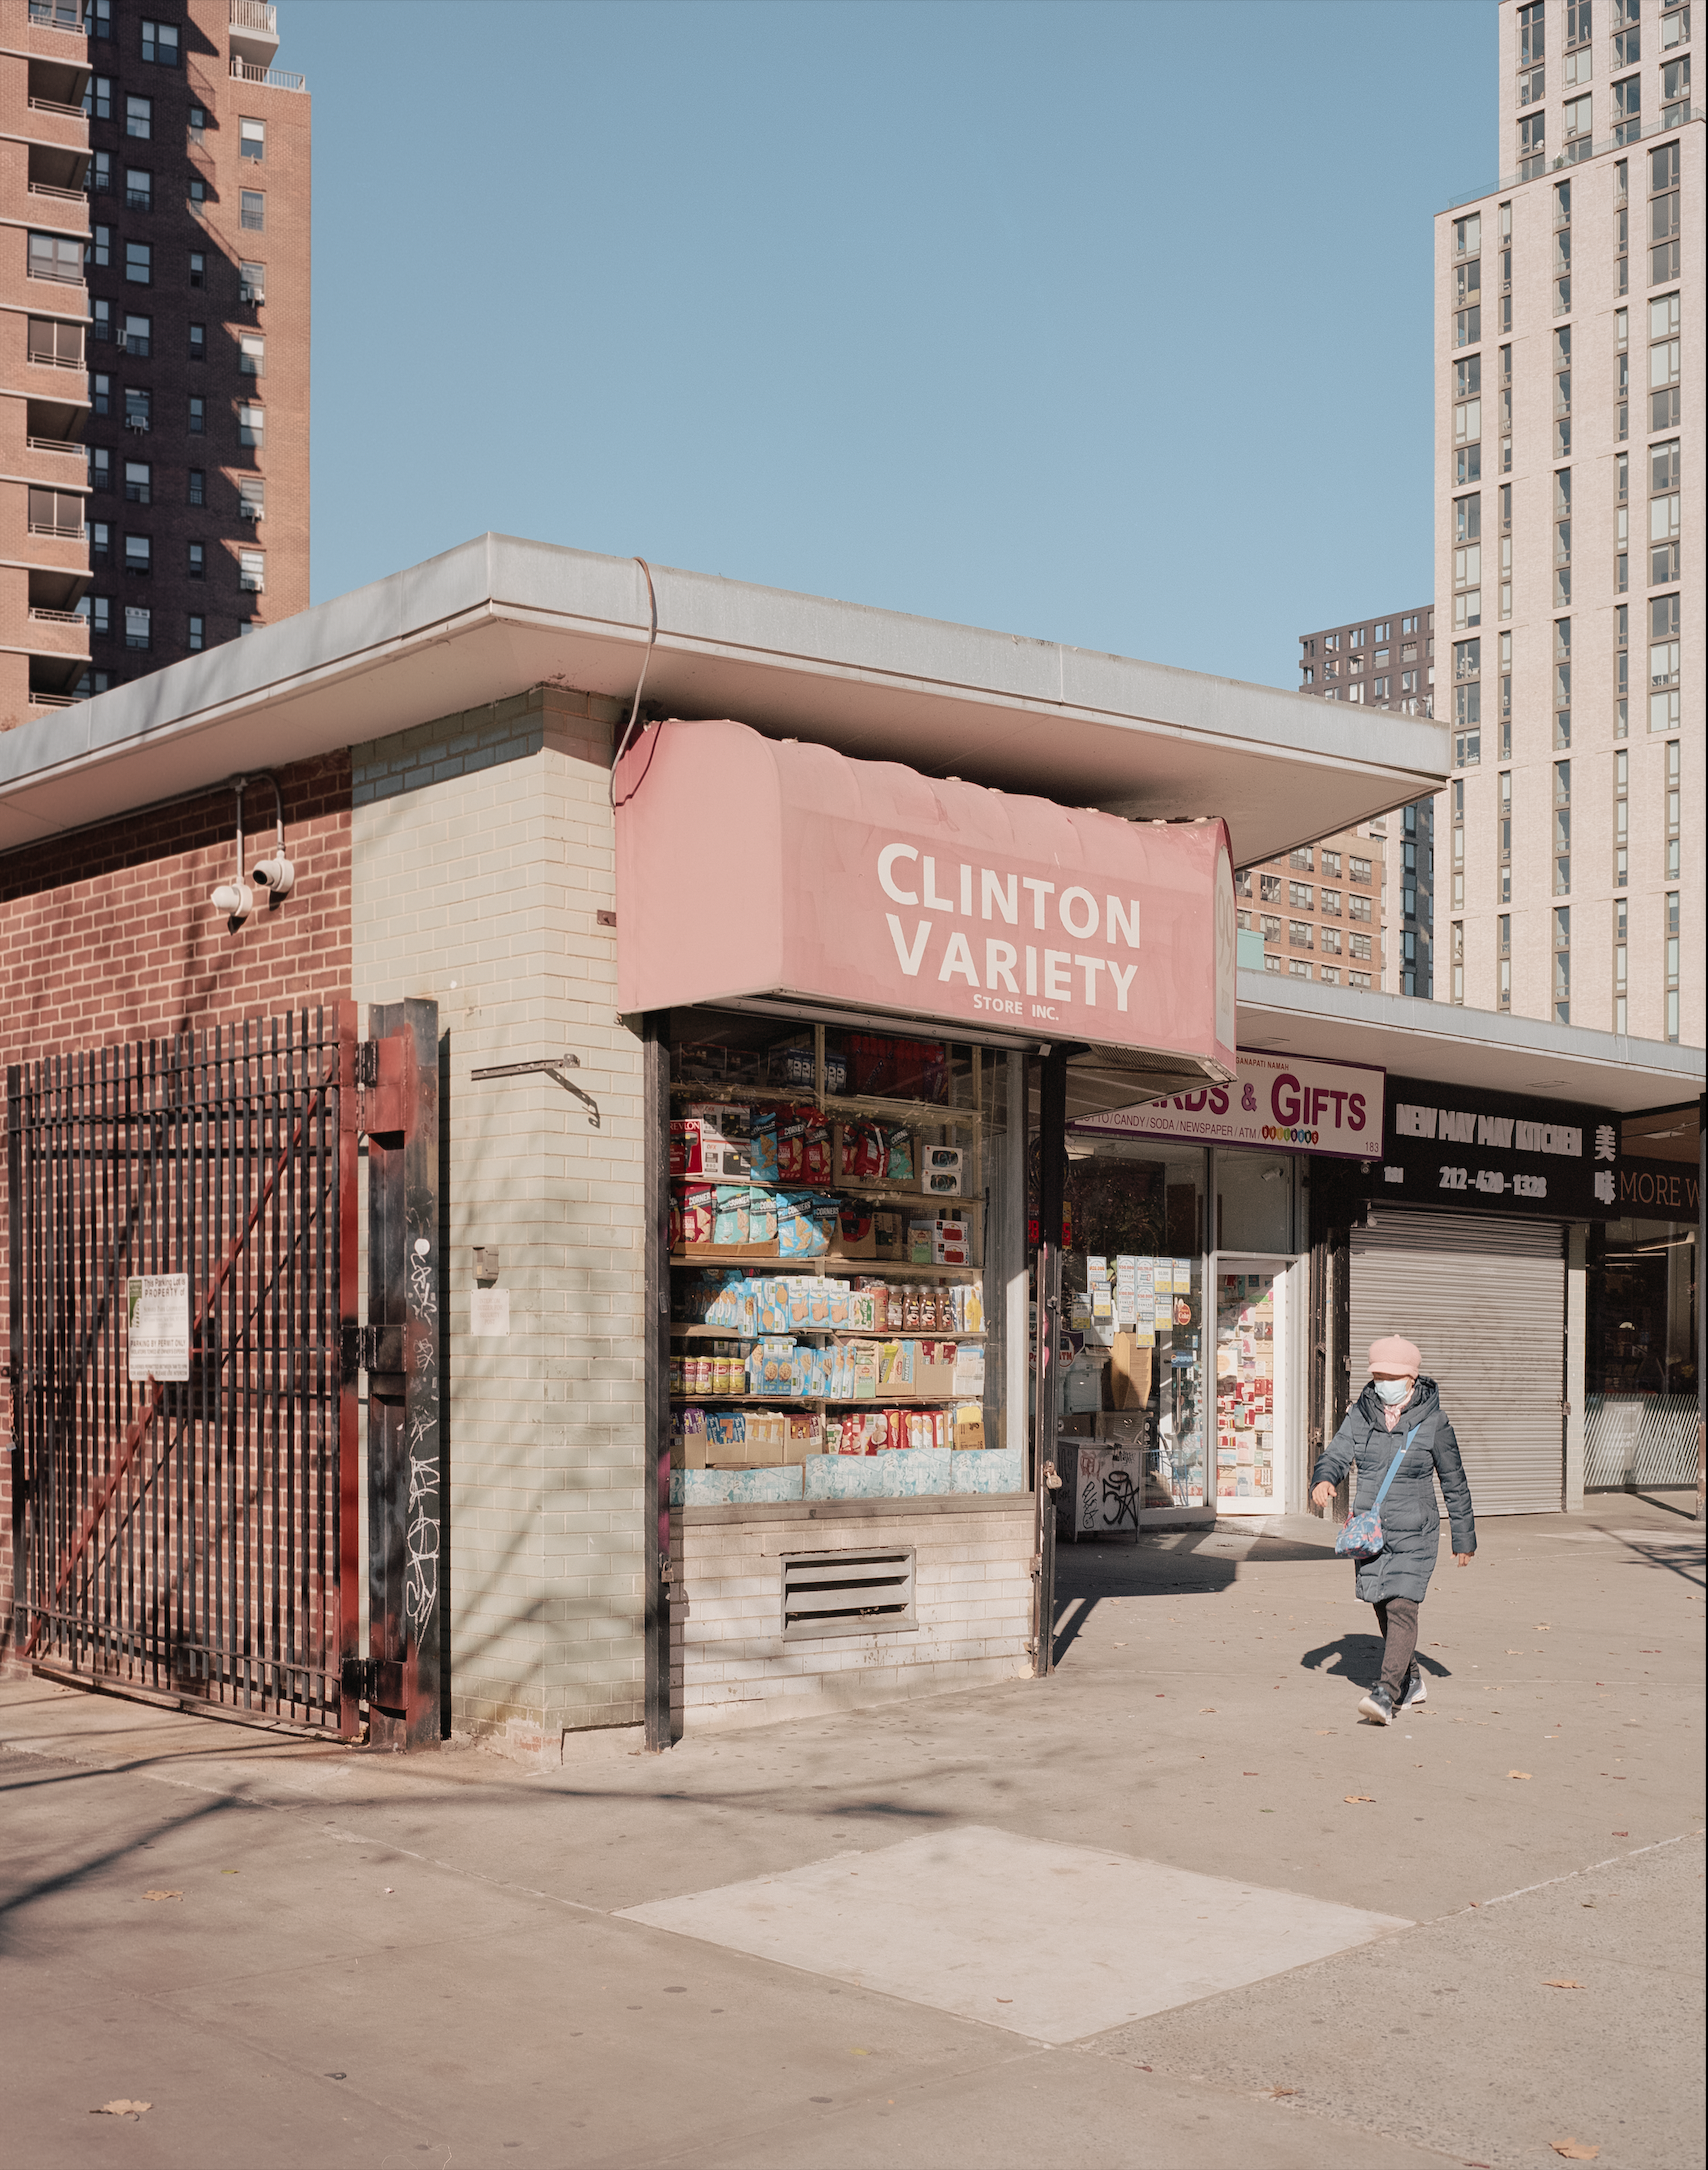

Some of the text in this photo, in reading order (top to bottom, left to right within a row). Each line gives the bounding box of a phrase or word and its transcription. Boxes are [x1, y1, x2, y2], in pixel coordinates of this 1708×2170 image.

[878, 843, 1140, 949] CLINTON
[885, 913, 1138, 1012] VARIETY
[973, 993, 1059, 1021] STORE INC.
[1267, 1061, 1289, 1071] NAMAH
[1241, 1083, 1257, 1112] &
[1271, 1073, 1366, 1131] GIFTS
[670, 1121, 700, 1130] REVLON
[1081, 1114, 1109, 1123] OTTO
[1114, 1113, 1145, 1127] CANDY
[1150, 1117, 1174, 1130] SODA
[1180, 1121, 1233, 1136] NEWSPAPER
[1240, 1127, 1256, 1139] ATM
[1396, 1103, 1582, 1157] NEW MAY MAY KITCHEN
[1365, 1141, 1379, 1152] 183
[1439, 1166, 1547, 1198] 212-420-1328
[1620, 1170, 1681, 1207] MORE
[144, 1279, 154, 1287] This
[154, 1279, 172, 1288] Parking
[173, 1278, 181, 1286] Lot
[145, 1288, 178, 1297] PROPERTY
[158, 1339, 174, 1347] PERMIT
